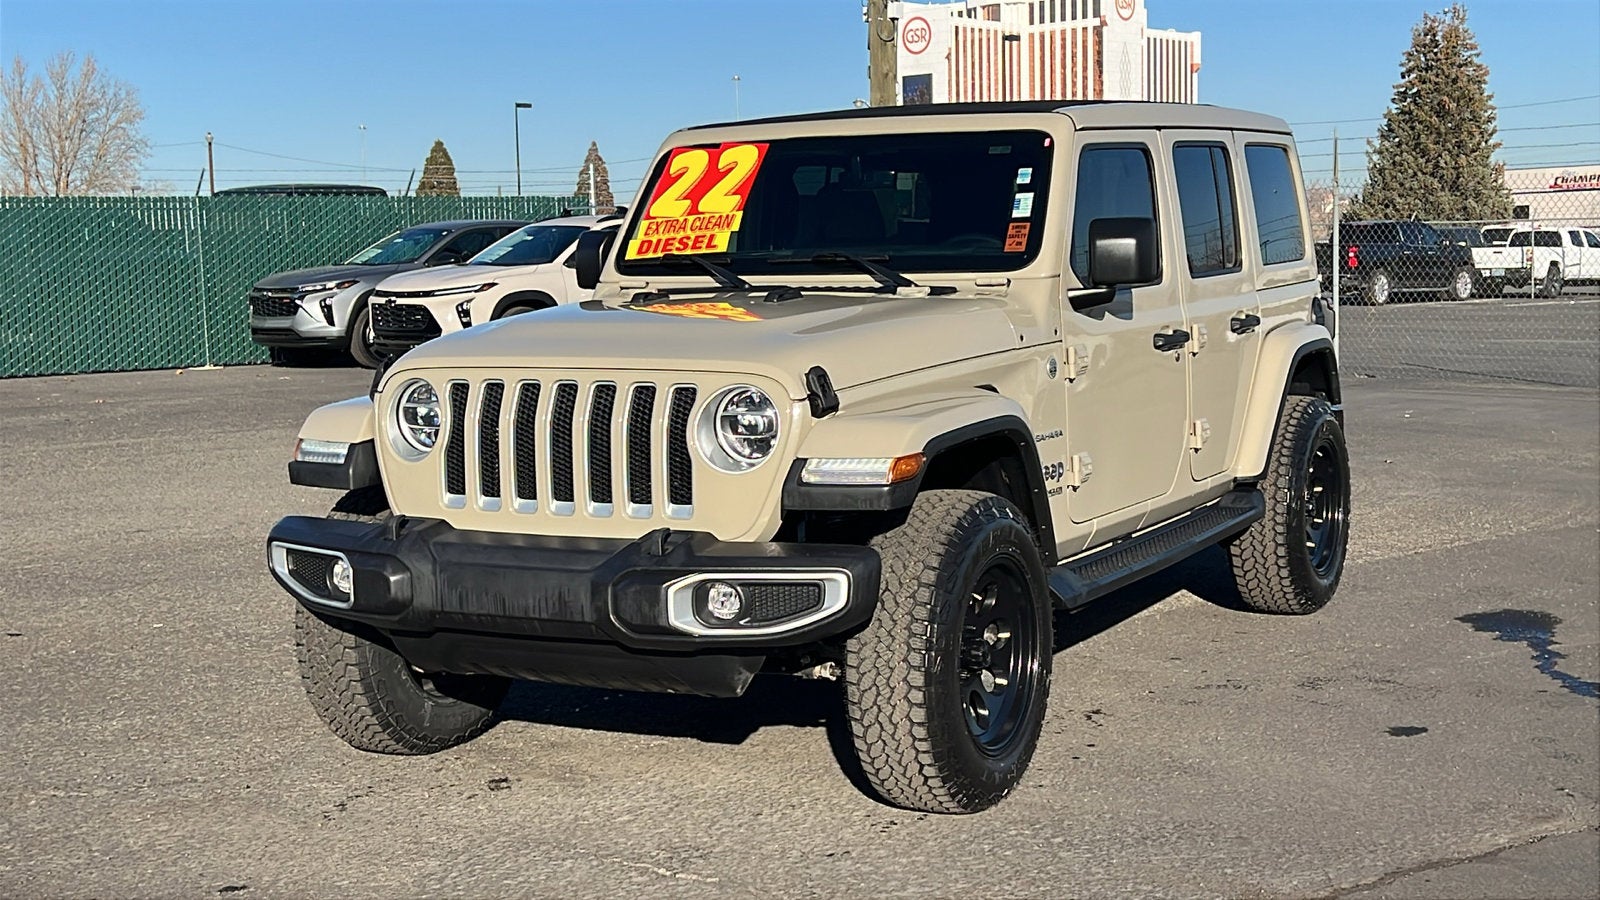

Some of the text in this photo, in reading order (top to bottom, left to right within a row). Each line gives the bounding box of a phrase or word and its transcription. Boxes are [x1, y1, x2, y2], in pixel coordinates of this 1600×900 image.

[905, 27, 928, 44] GSR
[649, 144, 759, 218] 22
[644, 214, 736, 236] EXTRA CLEAN
[636, 233, 718, 256] DIESEL
[1035, 430, 1063, 443] SAHARA
[1042, 461, 1064, 483] eep
